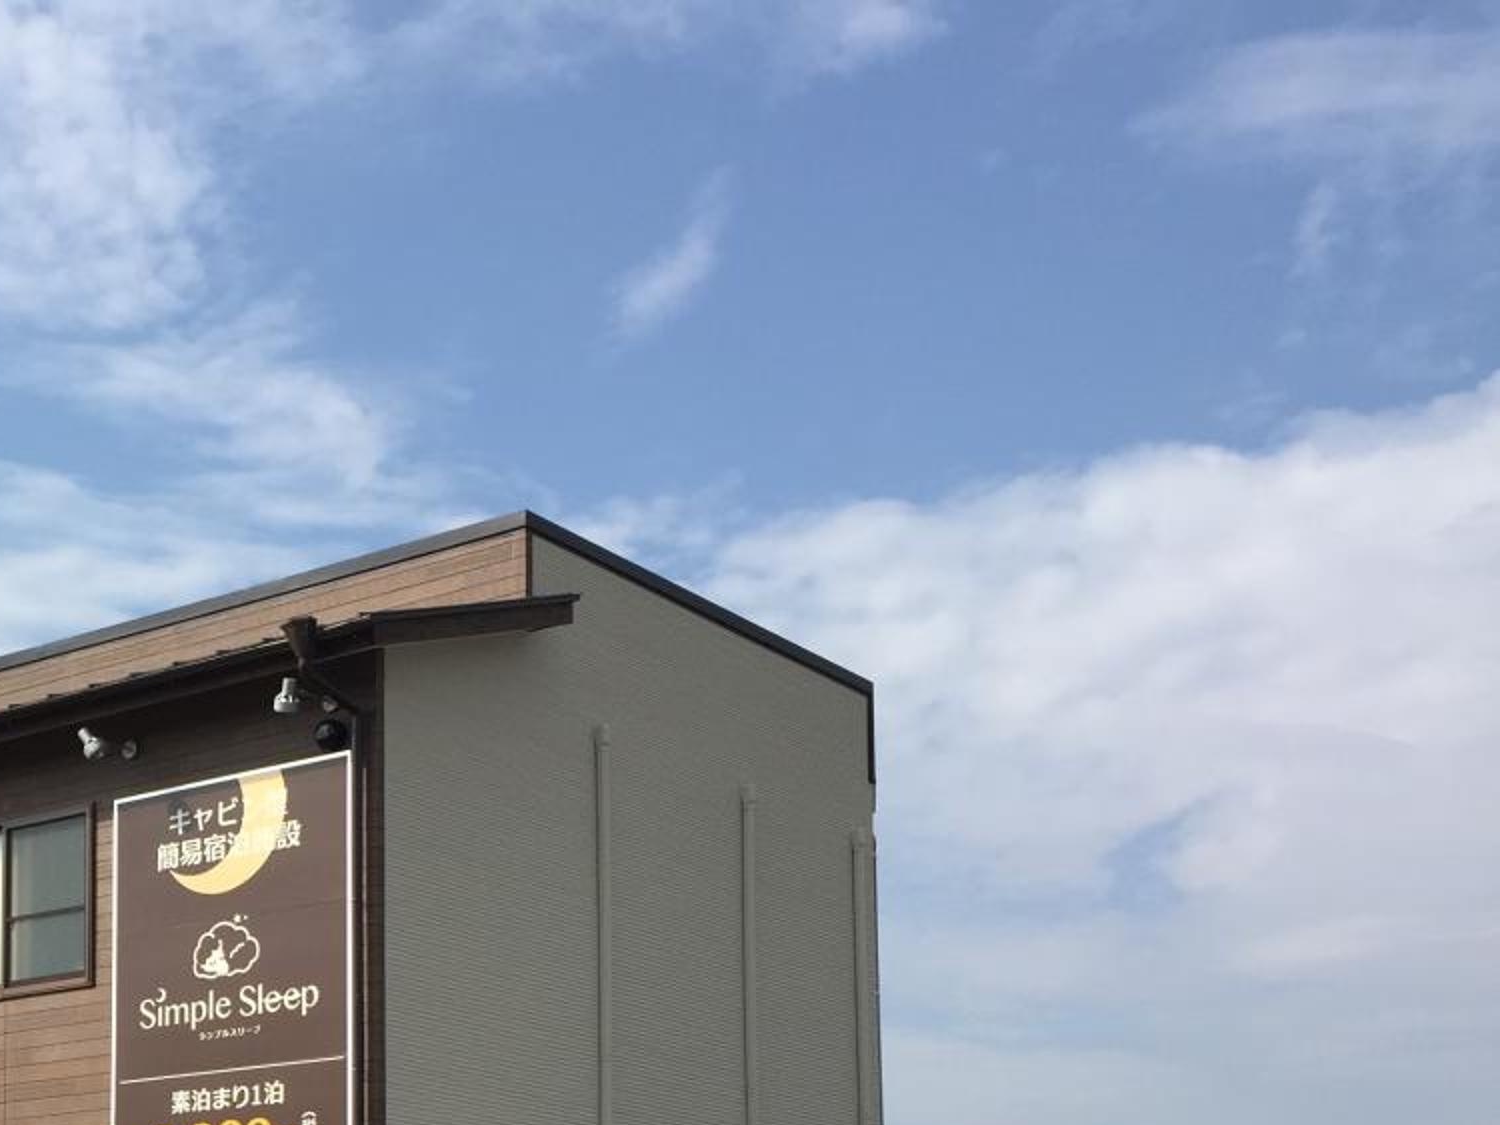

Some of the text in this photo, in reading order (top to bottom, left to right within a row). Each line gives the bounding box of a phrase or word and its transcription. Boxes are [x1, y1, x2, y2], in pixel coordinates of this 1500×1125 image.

[157, 818, 301, 872] 簡易宿設
[139, 983, 319, 1031] Simple Sleep
[171, 1080, 285, 1115] 素泊まり1泊
